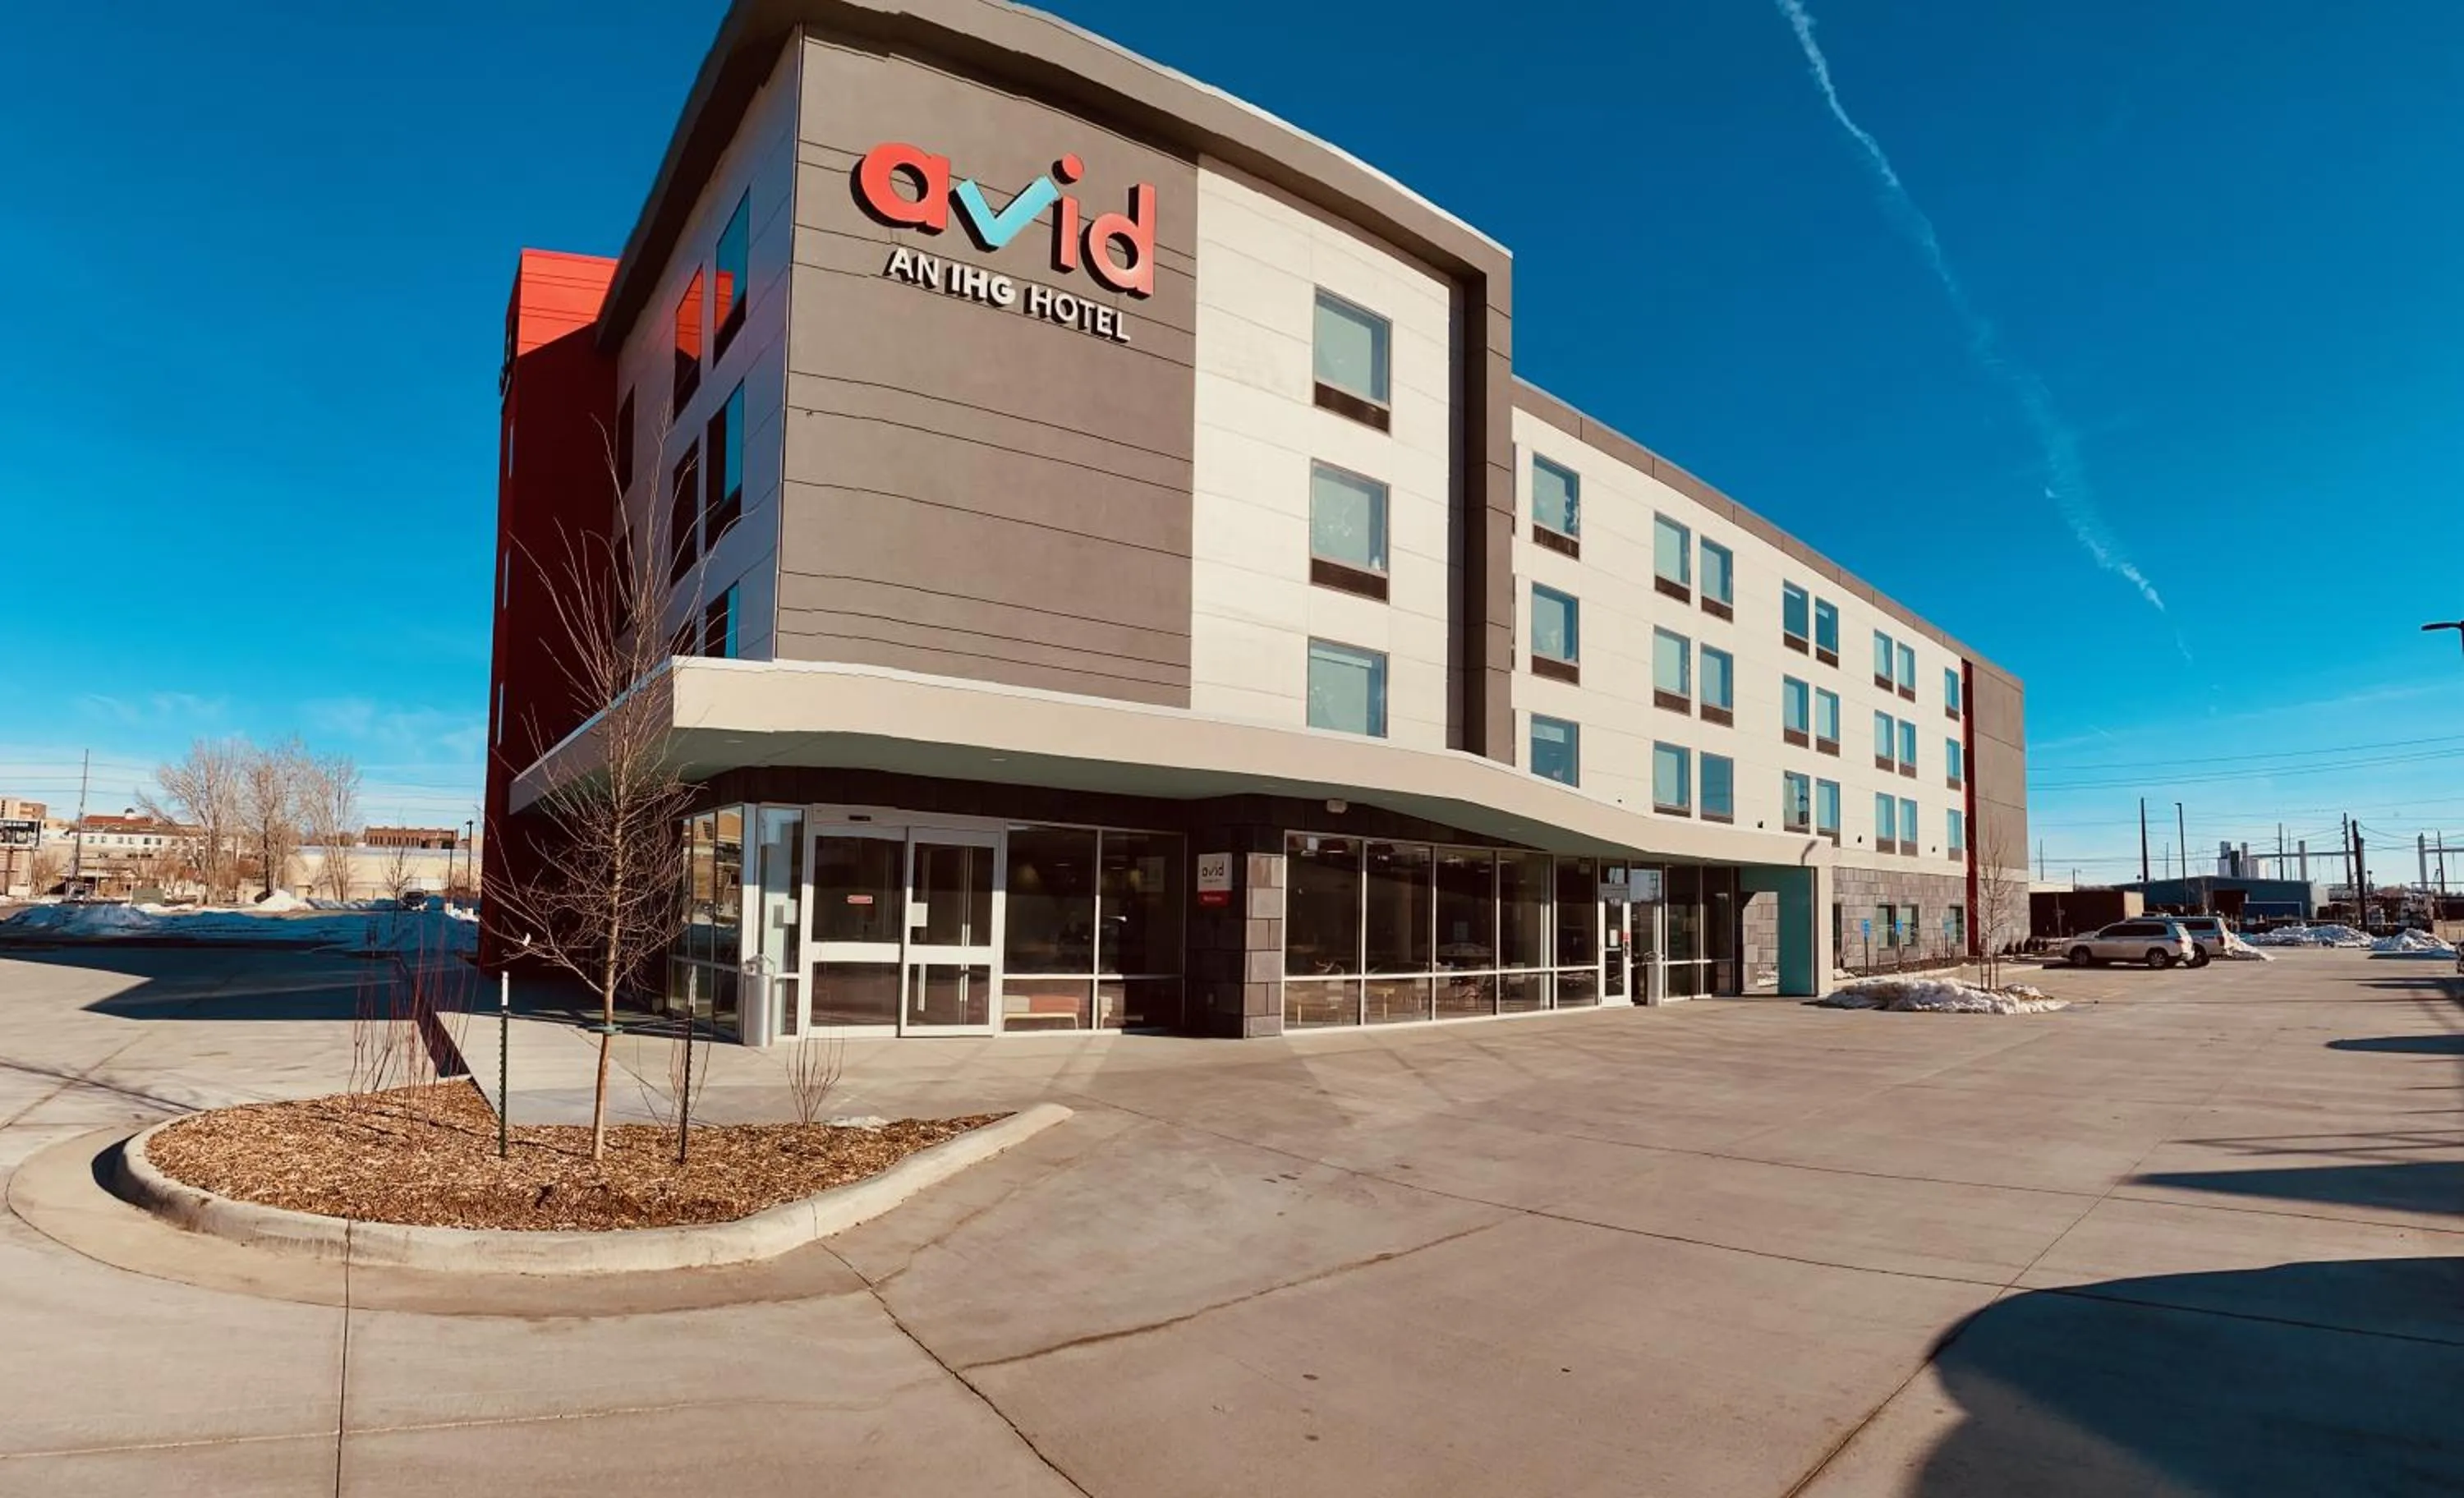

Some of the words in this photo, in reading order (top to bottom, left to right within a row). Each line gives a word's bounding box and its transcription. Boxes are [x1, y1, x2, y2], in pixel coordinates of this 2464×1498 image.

[850, 142, 1156, 300] avid
[884, 246, 940, 287] AN
[945, 263, 1016, 307] IHG
[1024, 284, 1130, 343] HOTEL
